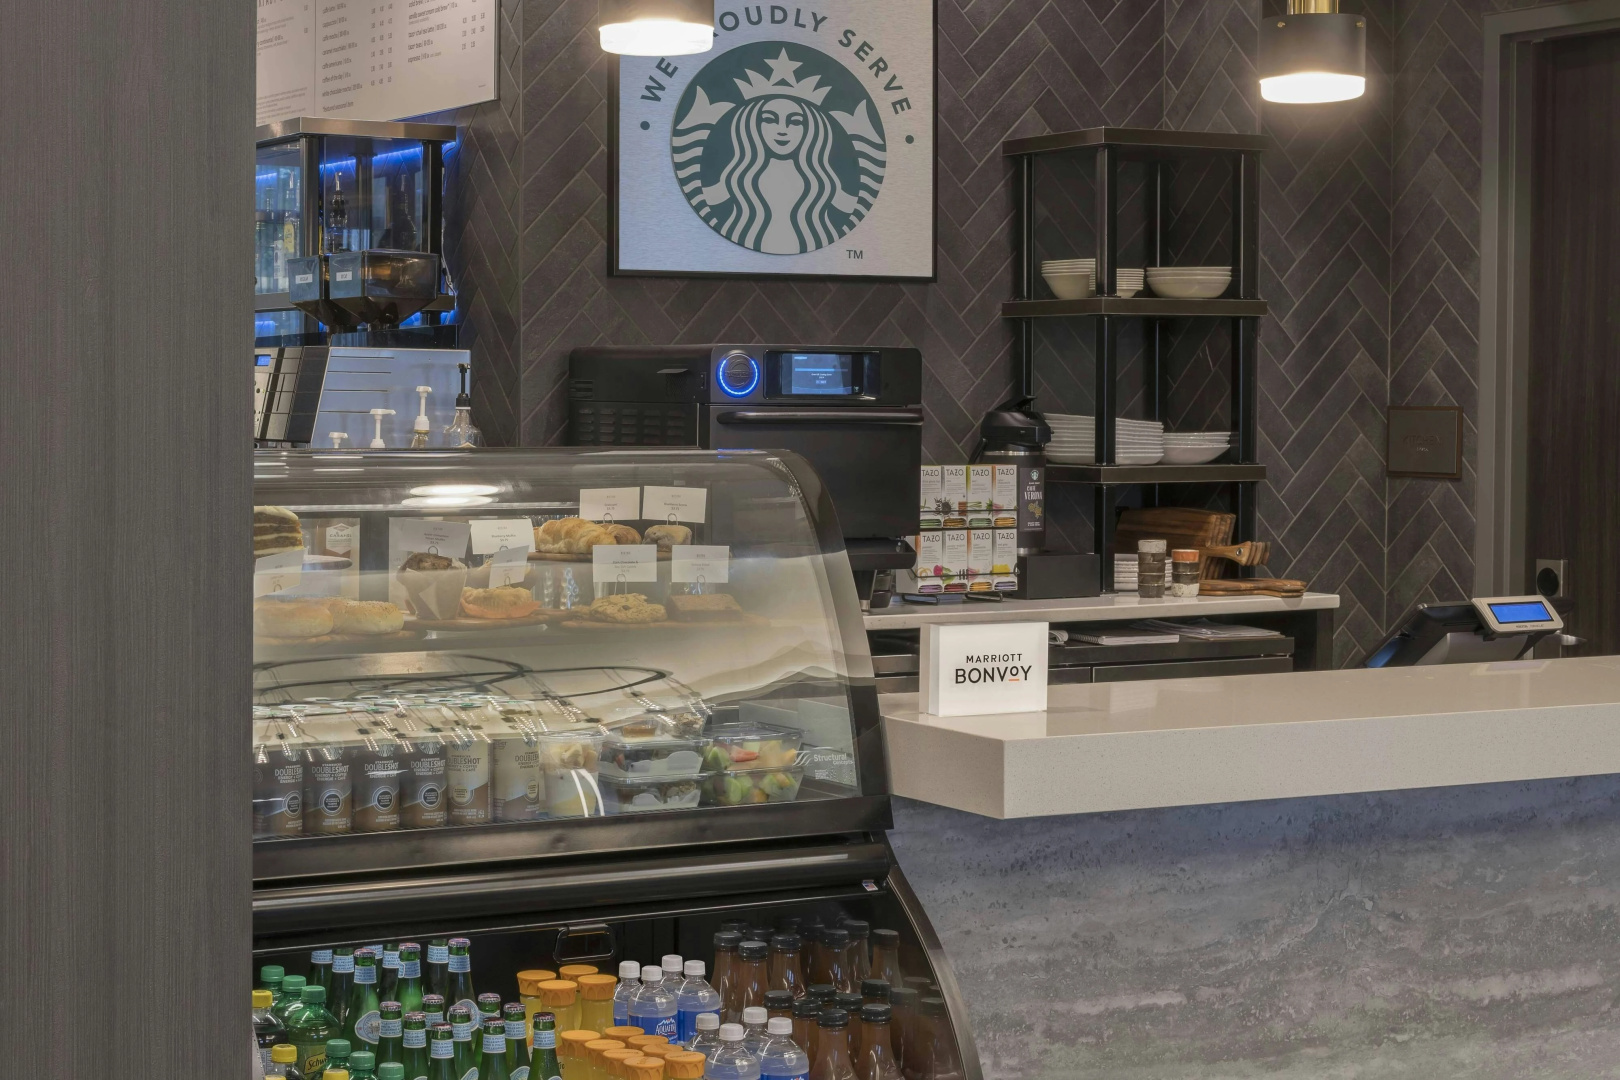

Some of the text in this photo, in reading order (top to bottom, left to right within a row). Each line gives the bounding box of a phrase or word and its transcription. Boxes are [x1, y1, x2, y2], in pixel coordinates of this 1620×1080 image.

[640, 5, 912, 115] WE OUDLY SERVE
[846, 249, 864, 260] TM
[1024, 492, 1043, 500] VERONA
[966, 654, 1022, 663] MARRIOTT
[955, 665, 1032, 684] BONVOY
[814, 753, 847, 761] Structural
[365, 762, 399, 771] DOUBLESHOT
[410, 760, 446, 768] DOUBLESHOT
[312, 765, 349, 773] DOUBLESHOT
[308, 1057, 327, 1070] Schw
